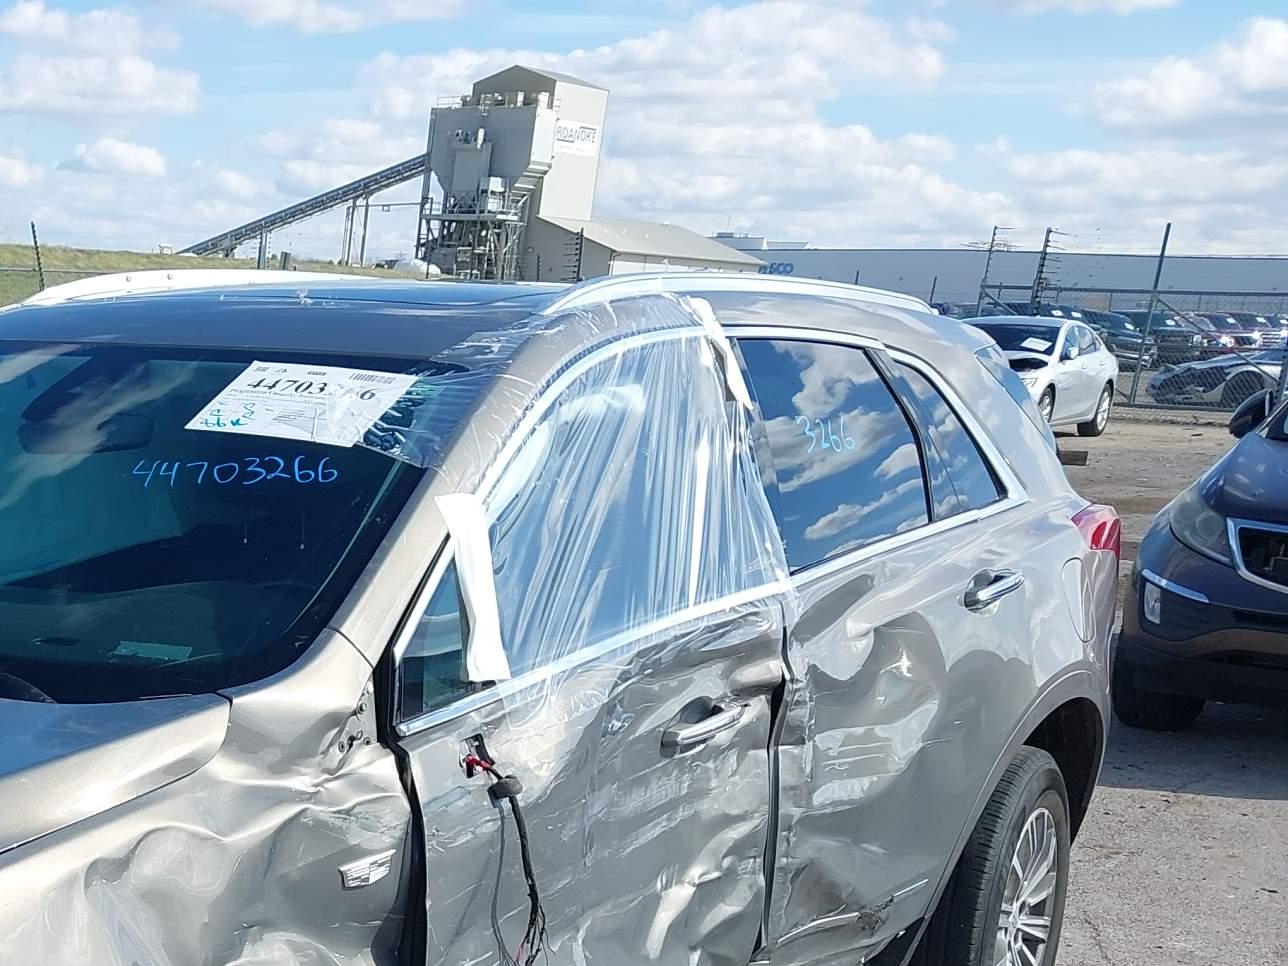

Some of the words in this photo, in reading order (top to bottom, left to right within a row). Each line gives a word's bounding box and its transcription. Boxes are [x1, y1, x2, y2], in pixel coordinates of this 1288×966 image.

[556, 126, 597, 144] ROANOKE
[247, 378, 379, 401] 447036
[796, 415, 857, 453] 3266
[132, 455, 339, 488] 44703266
